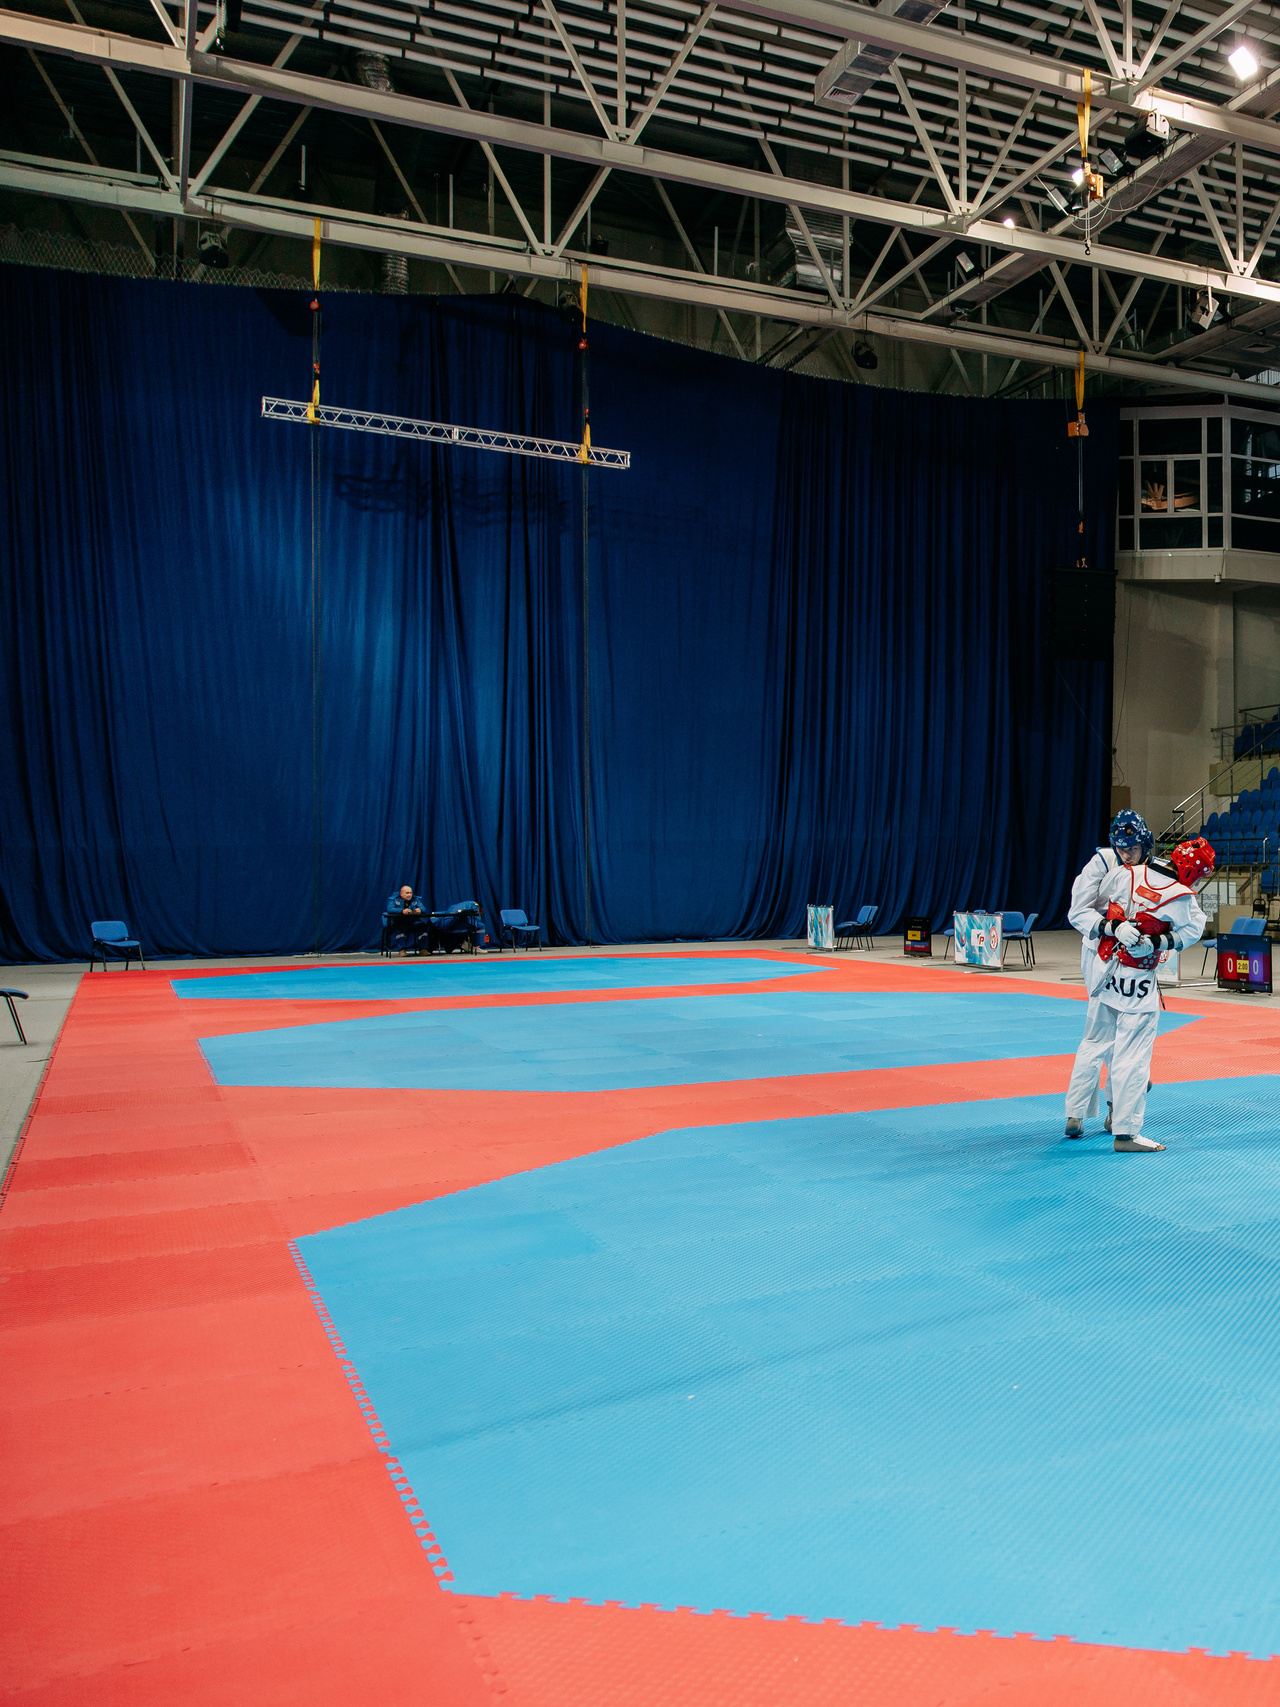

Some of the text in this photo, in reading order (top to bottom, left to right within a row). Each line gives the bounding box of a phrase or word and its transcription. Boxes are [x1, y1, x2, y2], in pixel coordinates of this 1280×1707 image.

[1227, 957, 1234, 973] 0
[1252, 959, 1259, 975] 0
[1105, 975, 1151, 999] RUS
